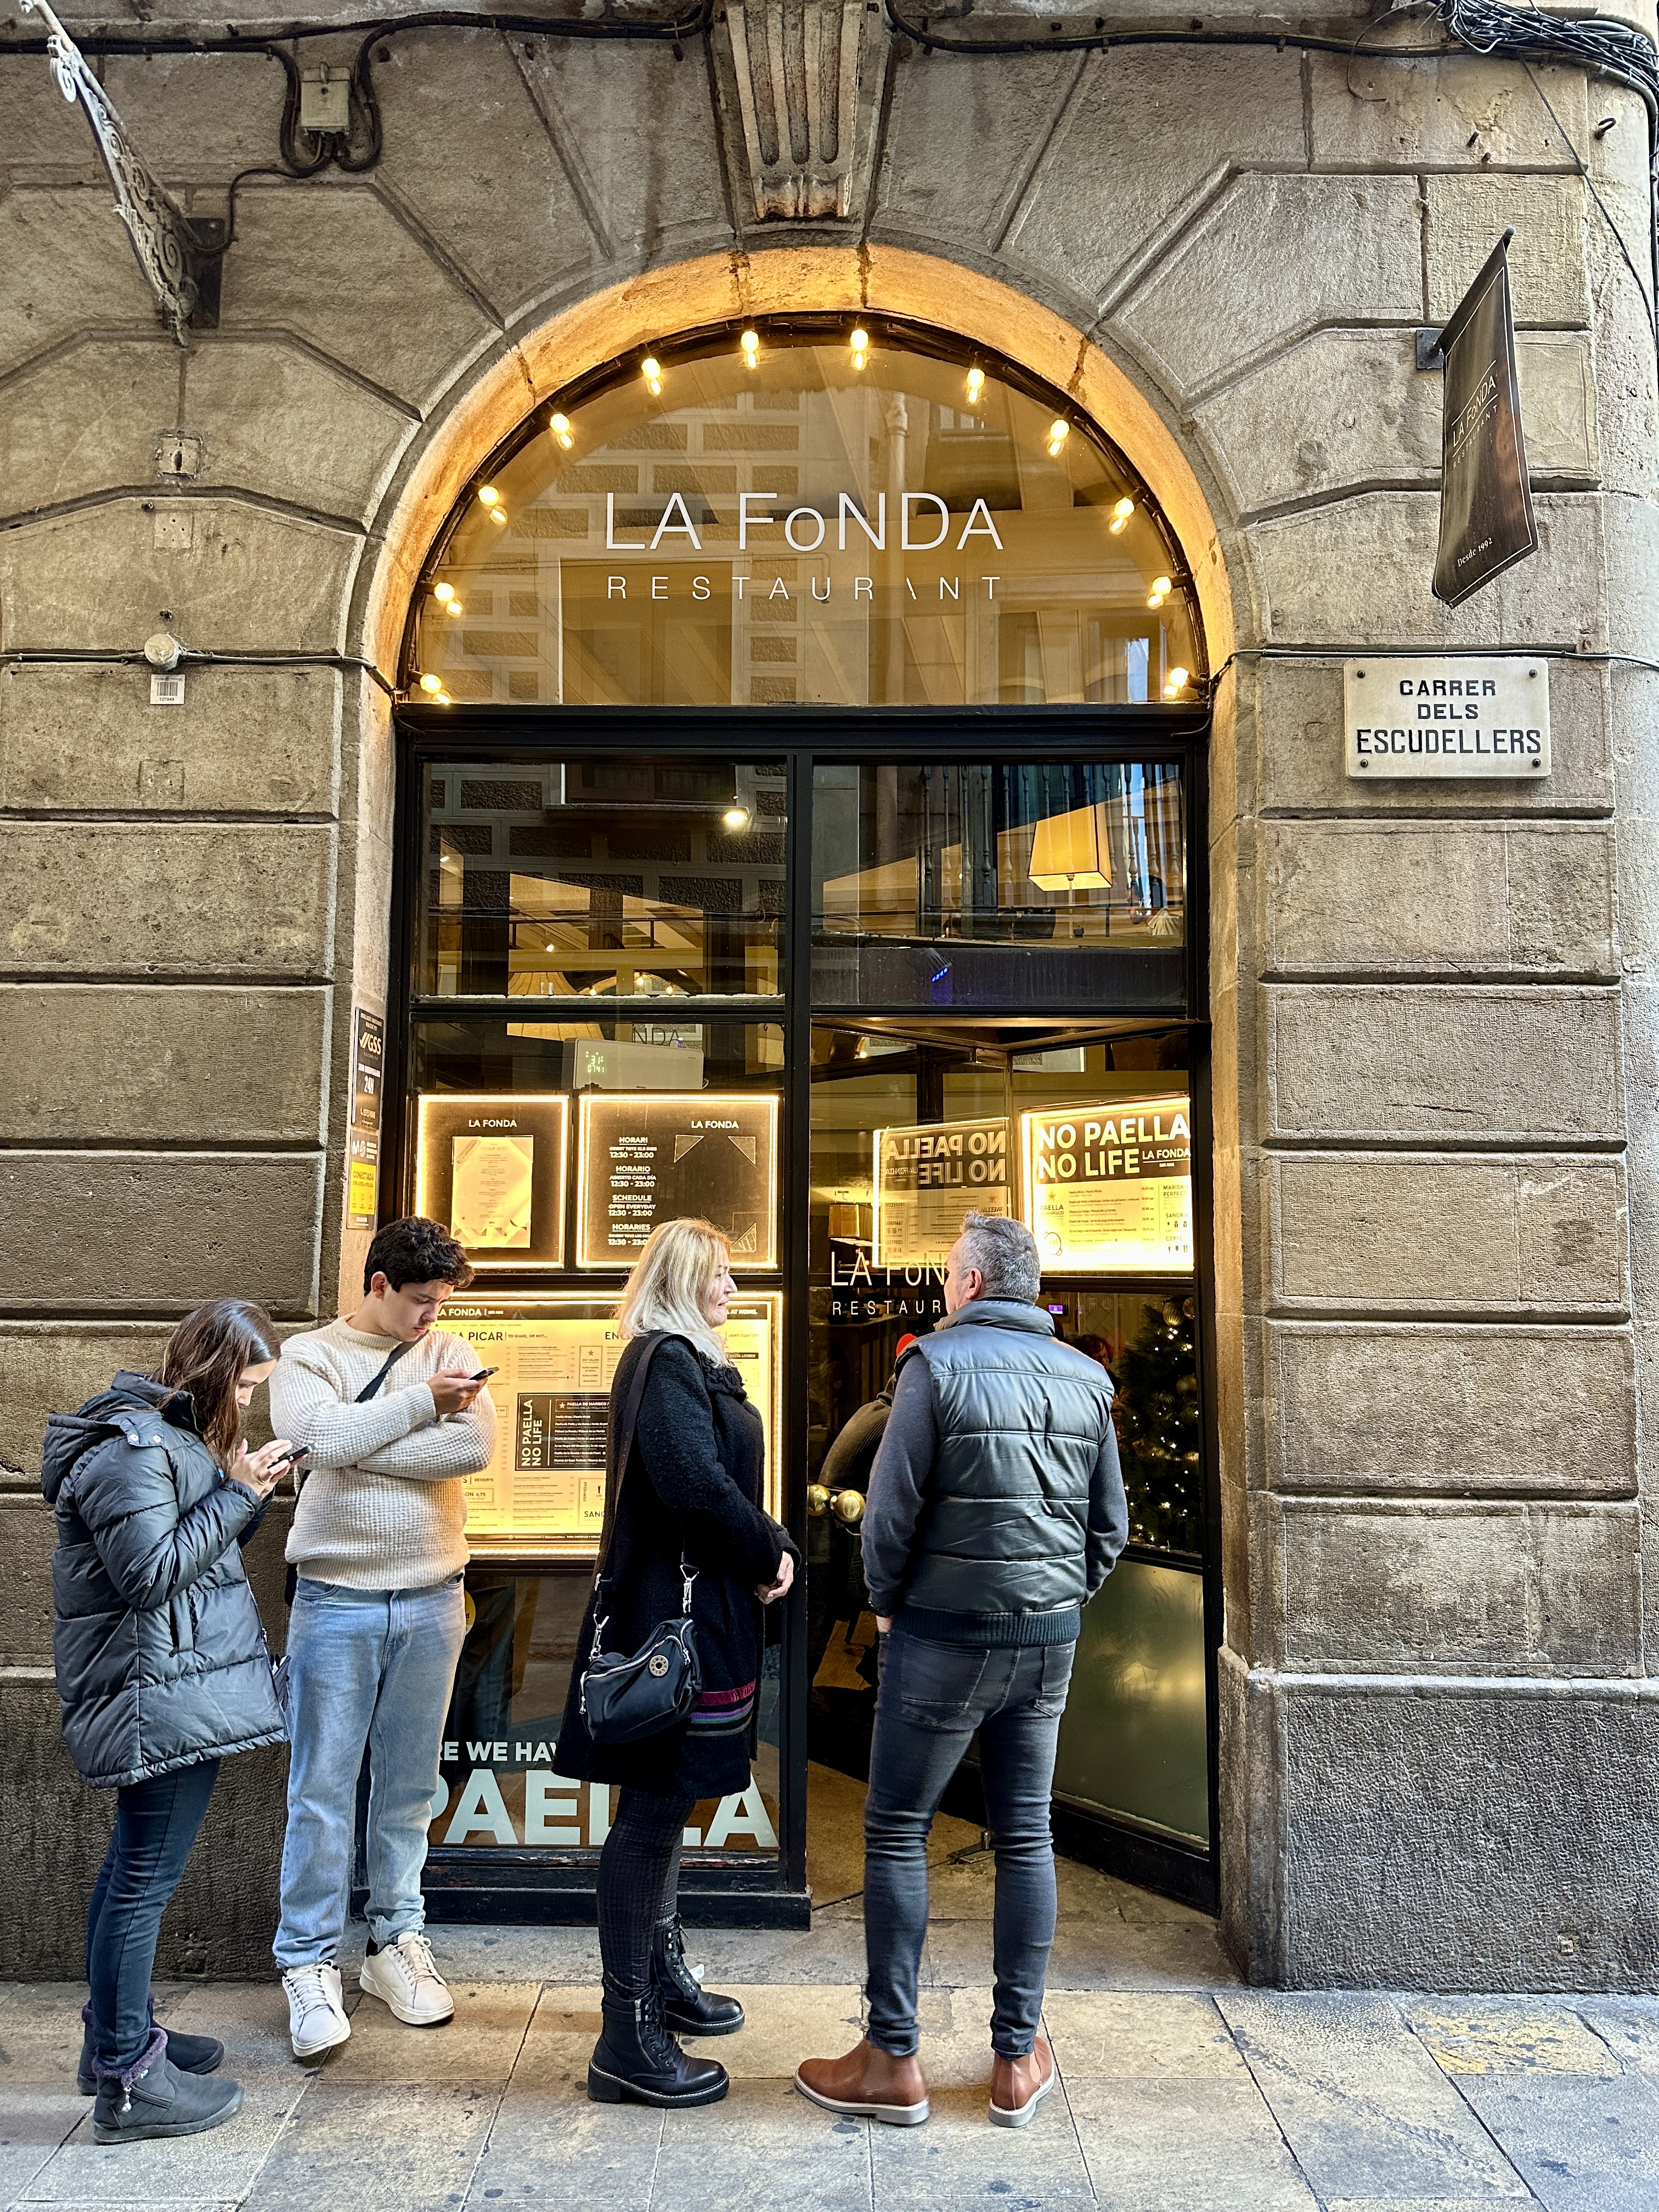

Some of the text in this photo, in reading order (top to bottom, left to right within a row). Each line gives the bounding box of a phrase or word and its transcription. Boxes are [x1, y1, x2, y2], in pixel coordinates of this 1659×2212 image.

[1453, 421, 1464, 448] LA
[1453, 404, 1498, 470] RESTAURANT
[606, 492, 1004, 551] LA FoNDA
[1457, 537, 1493, 567] Desde 1992
[1399, 680, 1497, 696] CARRER
[1418, 703, 1479, 720] DELS
[1357, 729, 1542, 754] ESCUDELLERS
[364, 1075, 375, 1094] 24H
[469, 1119, 517, 1128] LA FONDA
[691, 1120, 739, 1129] LA FONDA
[1039, 1113, 1190, 1151] NO PAELLA
[1039, 1148, 1140, 1179] NO LIFE
[1142, 1147, 1190, 1160] LA FONDA
[831, 1251, 945, 1286] LA FoN
[448, 1308, 482, 1316] FONDA
[832, 1300, 941, 1316] RESTAUR
[468, 1331, 503, 1341] PICAR
[521, 1399, 533, 1466] NO PAELLA
[532, 1420, 543, 1466] NO LIFE
[466, 1741, 508, 1762] WE
[427, 1768, 780, 1847] AELA
